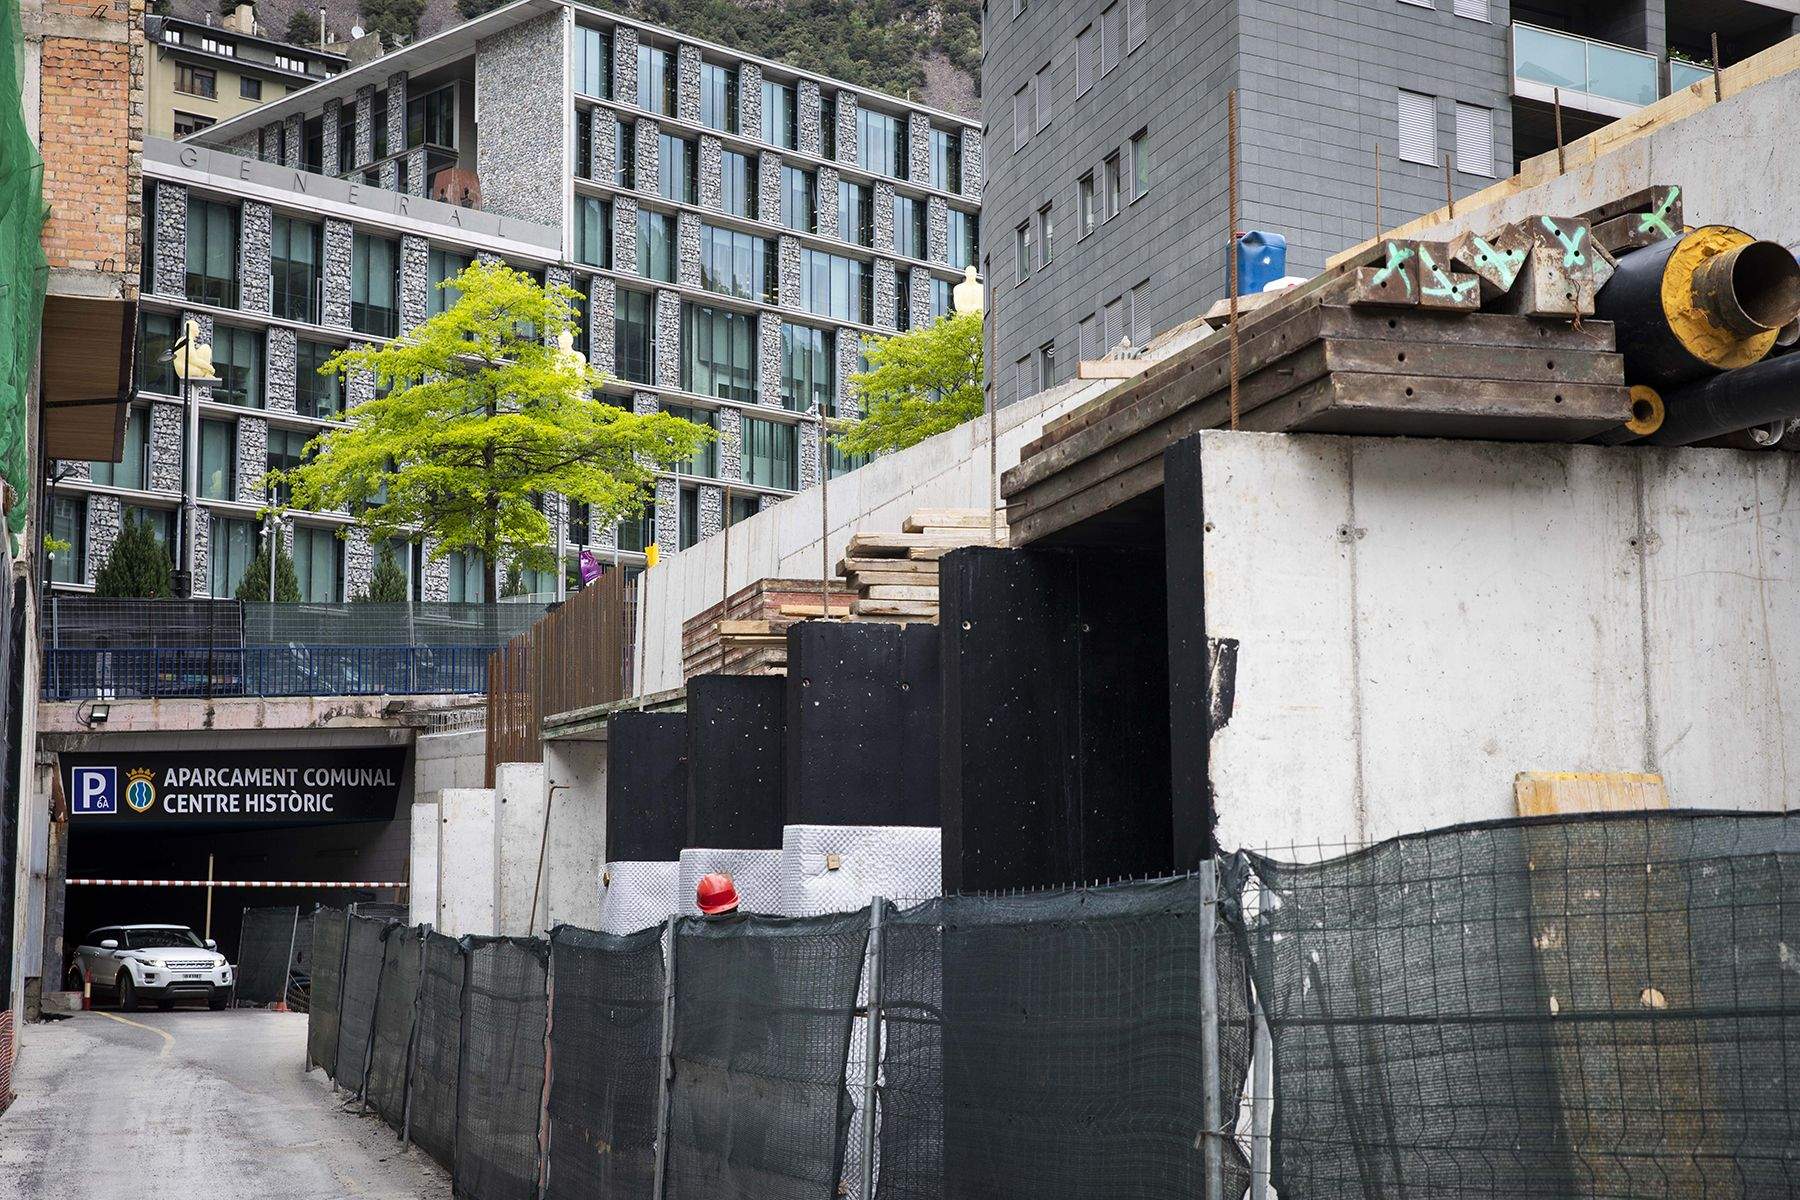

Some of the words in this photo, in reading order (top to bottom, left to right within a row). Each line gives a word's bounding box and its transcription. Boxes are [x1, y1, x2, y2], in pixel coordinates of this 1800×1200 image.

[163, 768, 299, 787] APARCAMENT
[303, 768, 396, 787] COMUNAL
[83, 772, 107, 808] P
[163, 794, 240, 813] CENTRE
[245, 790, 334, 813] HISTÒRIC
